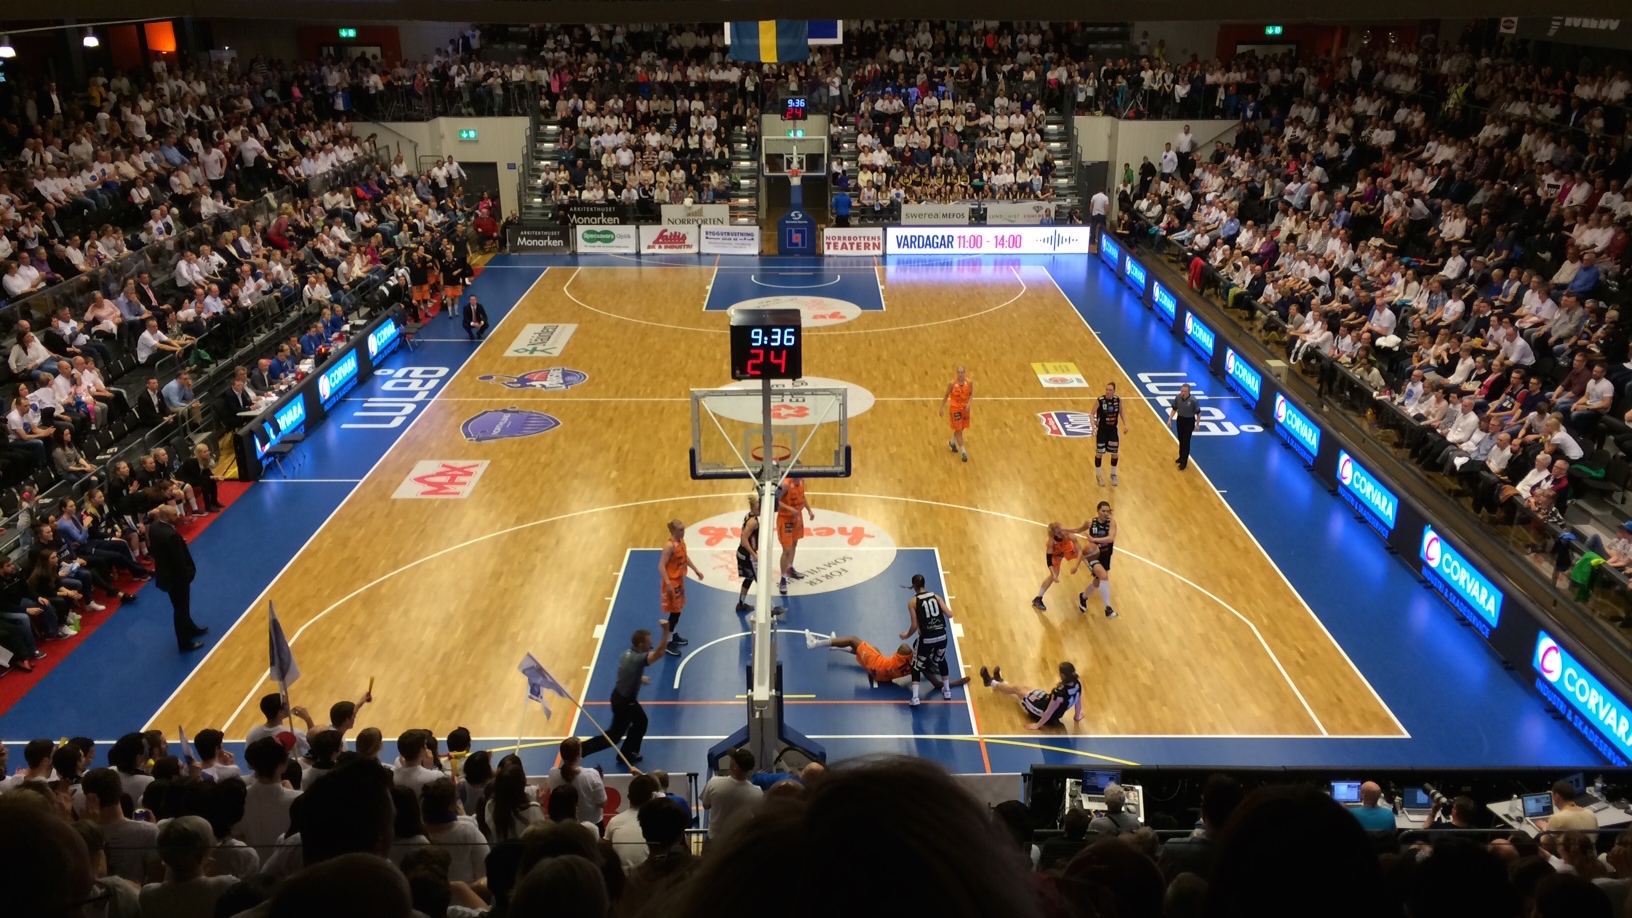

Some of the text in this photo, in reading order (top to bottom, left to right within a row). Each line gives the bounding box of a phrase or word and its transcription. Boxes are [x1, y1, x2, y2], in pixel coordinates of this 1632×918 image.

[787, 98, 805, 108] 9:36
[786, 107, 802, 119] 24
[667, 217, 724, 226] NORRPORTEN
[905, 212, 939, 220] swerea
[517, 236, 564, 247] Monarken
[825, 241, 881, 251] TEATERN
[896, 234, 954, 249] VARDAGAR
[957, 234, 983, 249] 11:00
[994, 234, 1022, 249] 14:00
[751, 328, 796, 346] 9:36
[747, 349, 787, 376] 24
[1234, 361, 1259, 395] CORVARA
[1286, 409, 1318, 450] CORVARA
[411, 462, 482, 497] MAX
[1353, 471, 1393, 521] CORVARA
[698, 526, 876, 547] heb
[823, 555, 853, 569] SOM
[805, 577, 824, 587] ER
[824, 567, 849, 581] FÖR
[1442, 553, 1495, 617] CORVARA
[921, 597, 941, 618] 10
[1535, 677, 1567, 715] INDUSTRI
